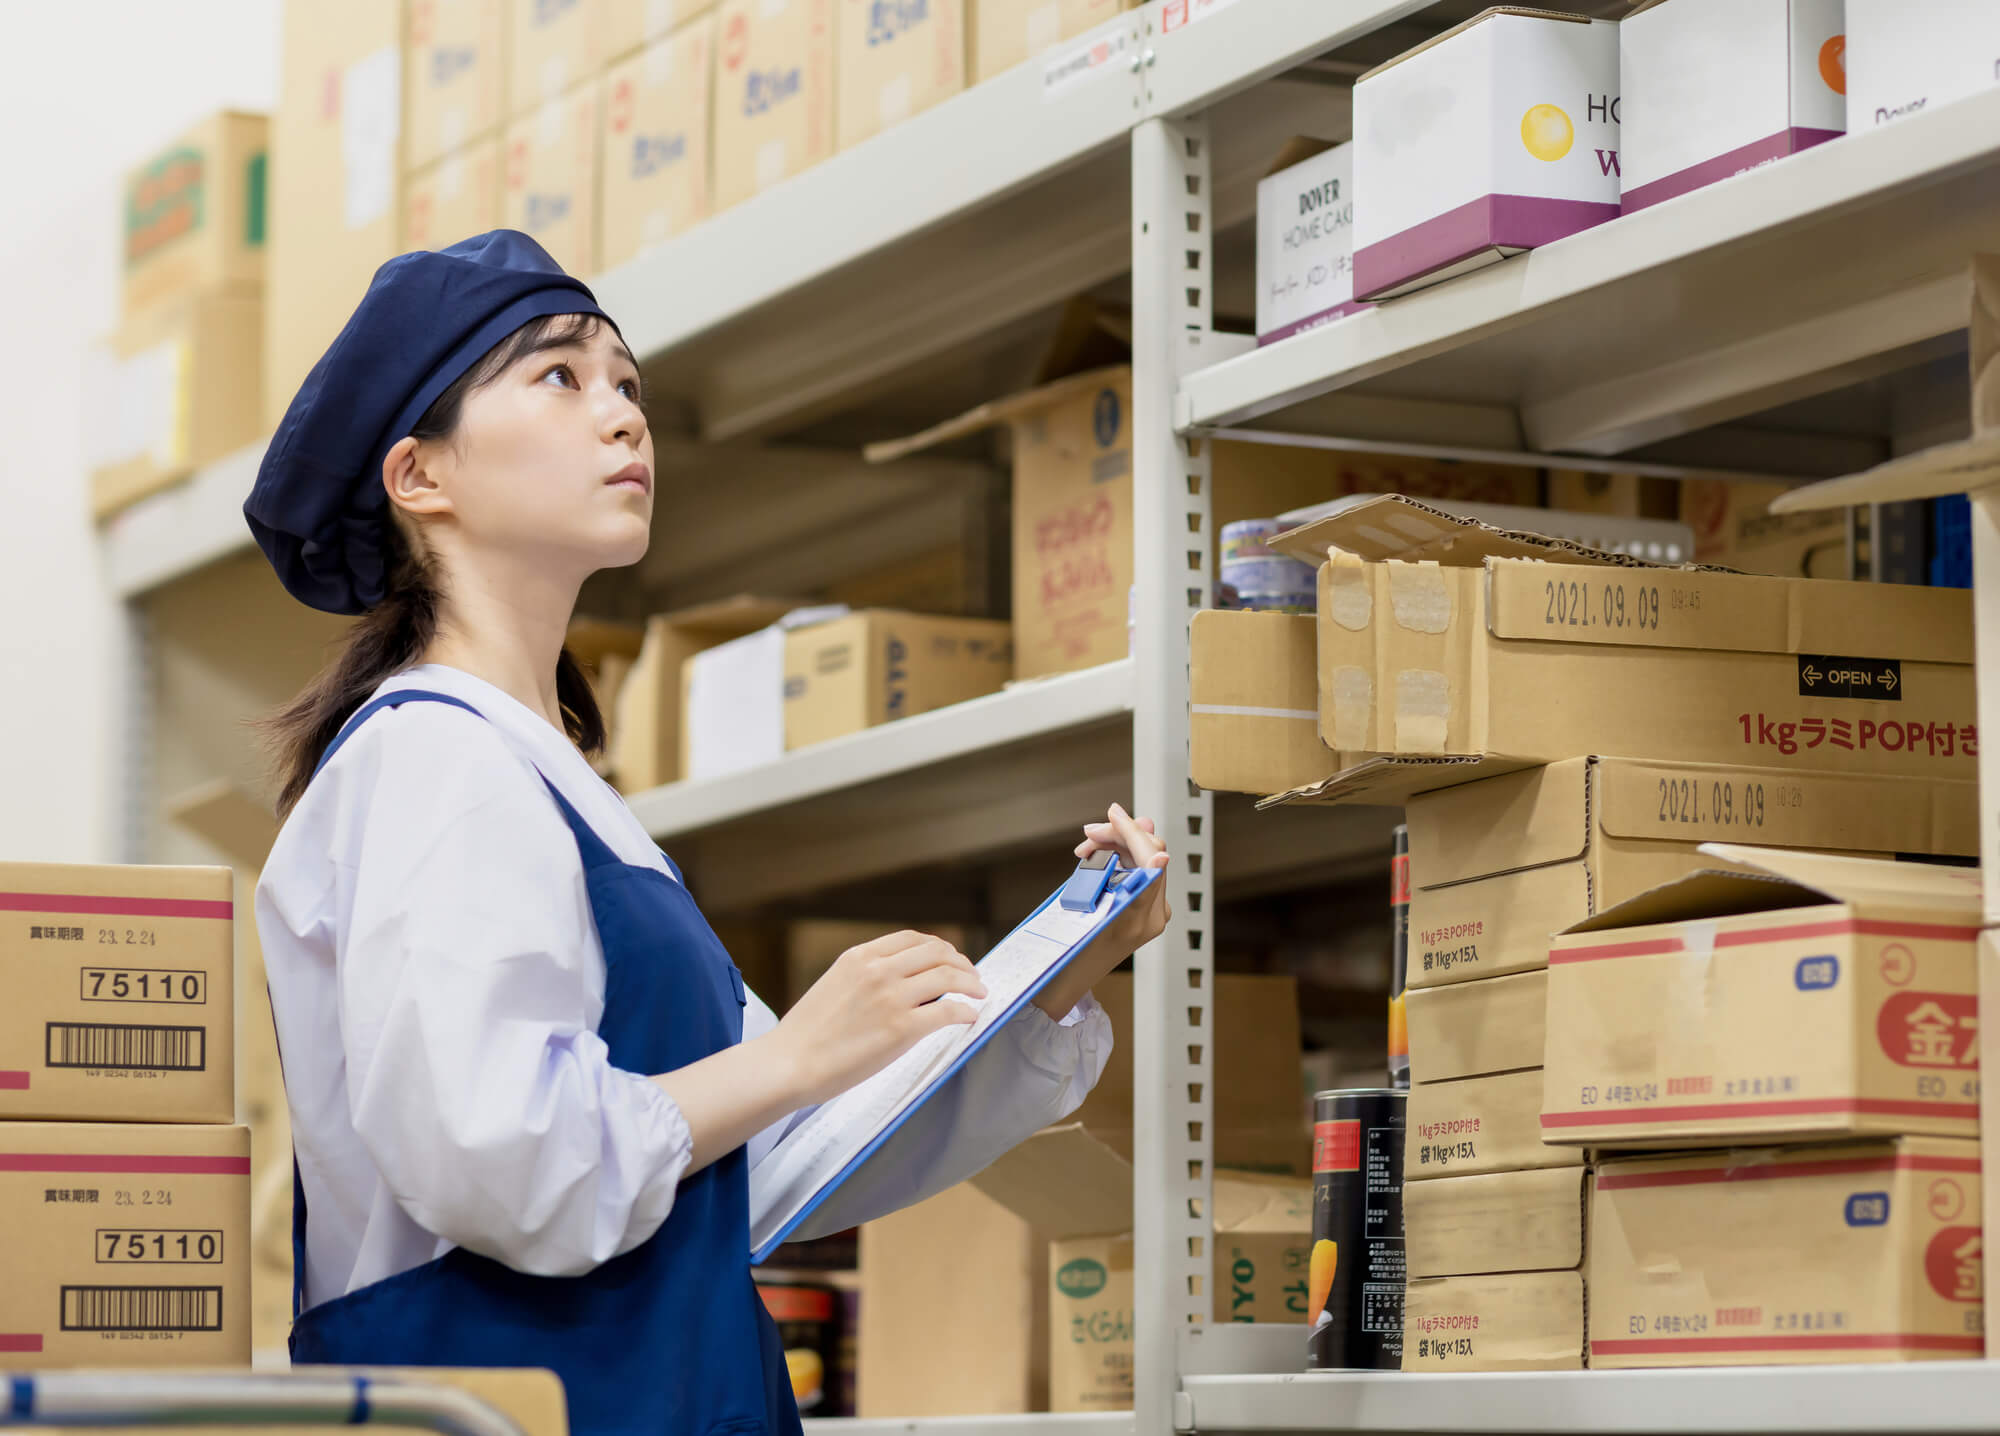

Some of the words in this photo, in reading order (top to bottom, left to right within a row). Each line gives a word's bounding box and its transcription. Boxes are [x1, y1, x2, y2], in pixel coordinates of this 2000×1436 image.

[1299, 177, 1340, 217] DOVER
[1323, 201, 1353, 236] CAK
[1545, 580, 1659, 630] 2021.09.09
[1828, 669, 1872, 686] OPEN
[1738, 713, 1979, 756] 1kgラミPOP付き
[1658, 778, 1765, 827] 2021.09.09
[30, 926, 84, 941] 賞味期限
[1420, 921, 1484, 946] 1kgラミPOP付き
[89, 972, 199, 999] 75110
[1418, 1117, 1481, 1140] 1kgラミPOP付き
[44, 1189, 99, 1203] 賞味期限
[104, 1234, 216, 1260] 75110
[1417, 1315, 1480, 1334] 1kgラミPOP付き
